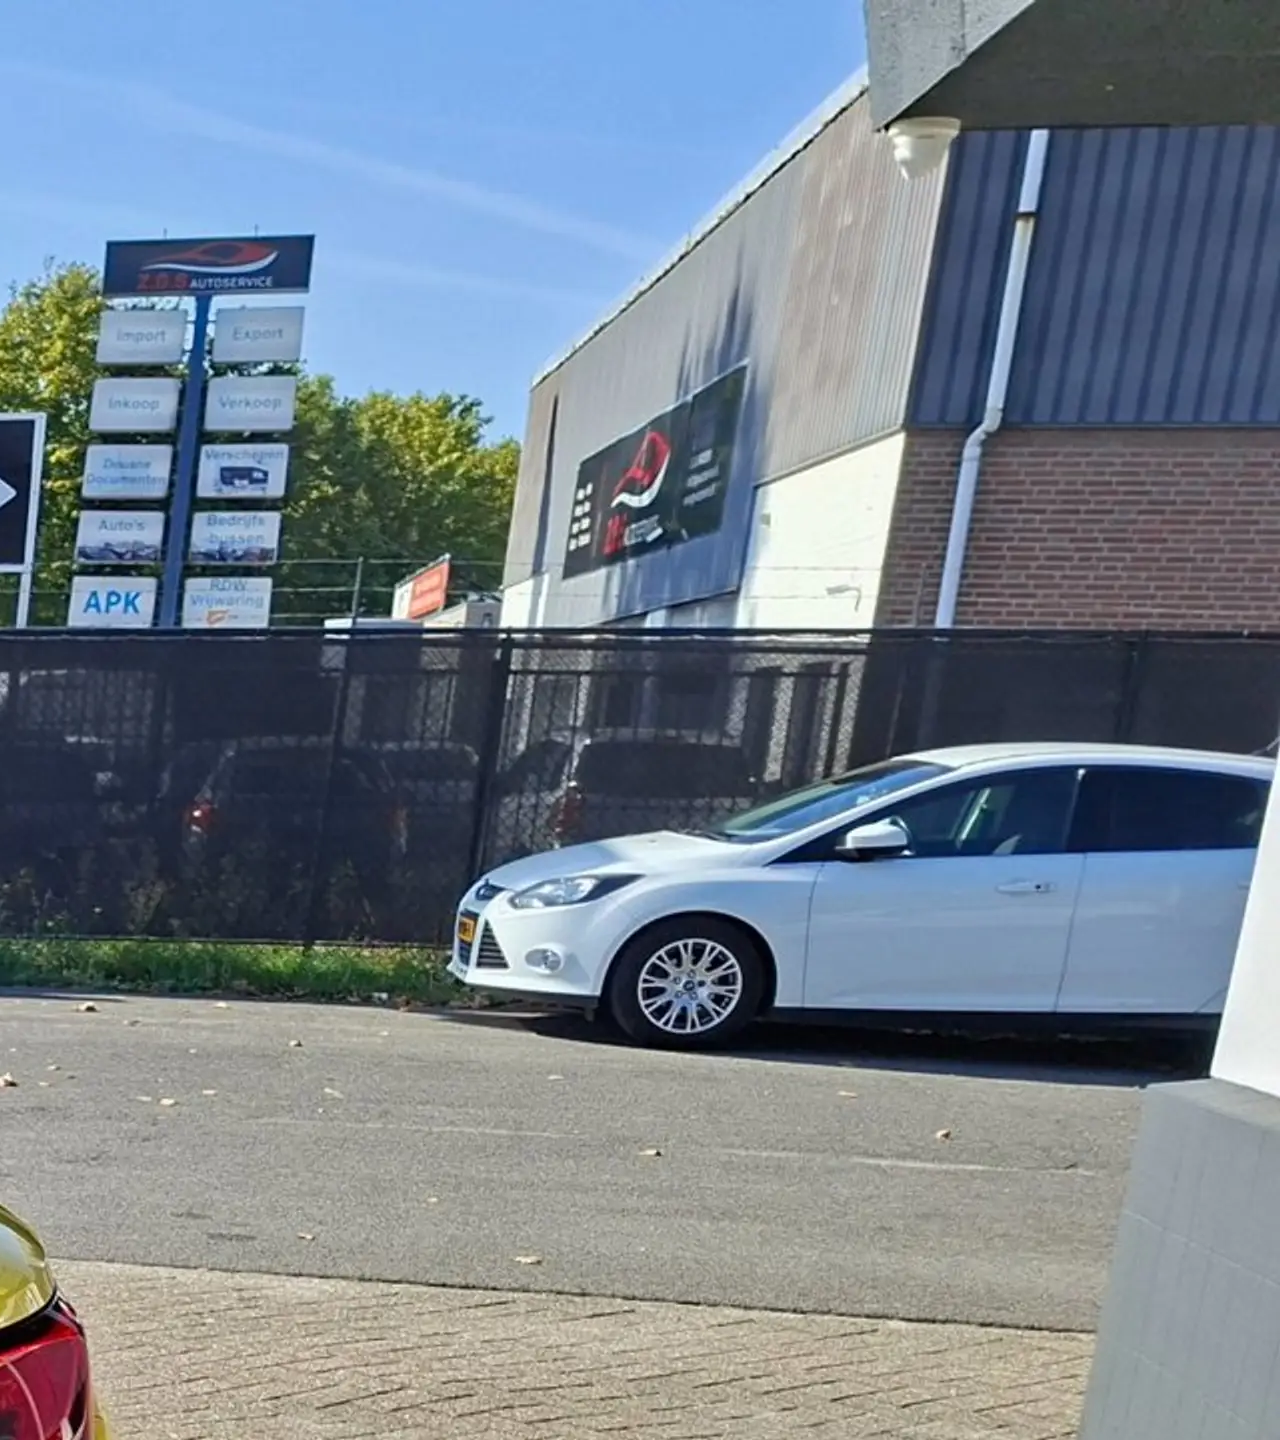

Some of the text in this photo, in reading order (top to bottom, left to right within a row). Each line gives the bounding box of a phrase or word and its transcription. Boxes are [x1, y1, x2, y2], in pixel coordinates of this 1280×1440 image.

[190, 276, 274, 290] AUTOSERVICE
[116, 328, 167, 344] Import
[232, 326, 284, 342] Export
[108, 396, 160, 411] Inkoop
[218, 395, 283, 410] Verkoop
[98, 518, 146, 531] Auto's
[209, 578, 248, 591] RDW
[83, 590, 143, 614] APK
[189, 594, 265, 608] Vrijwaring
